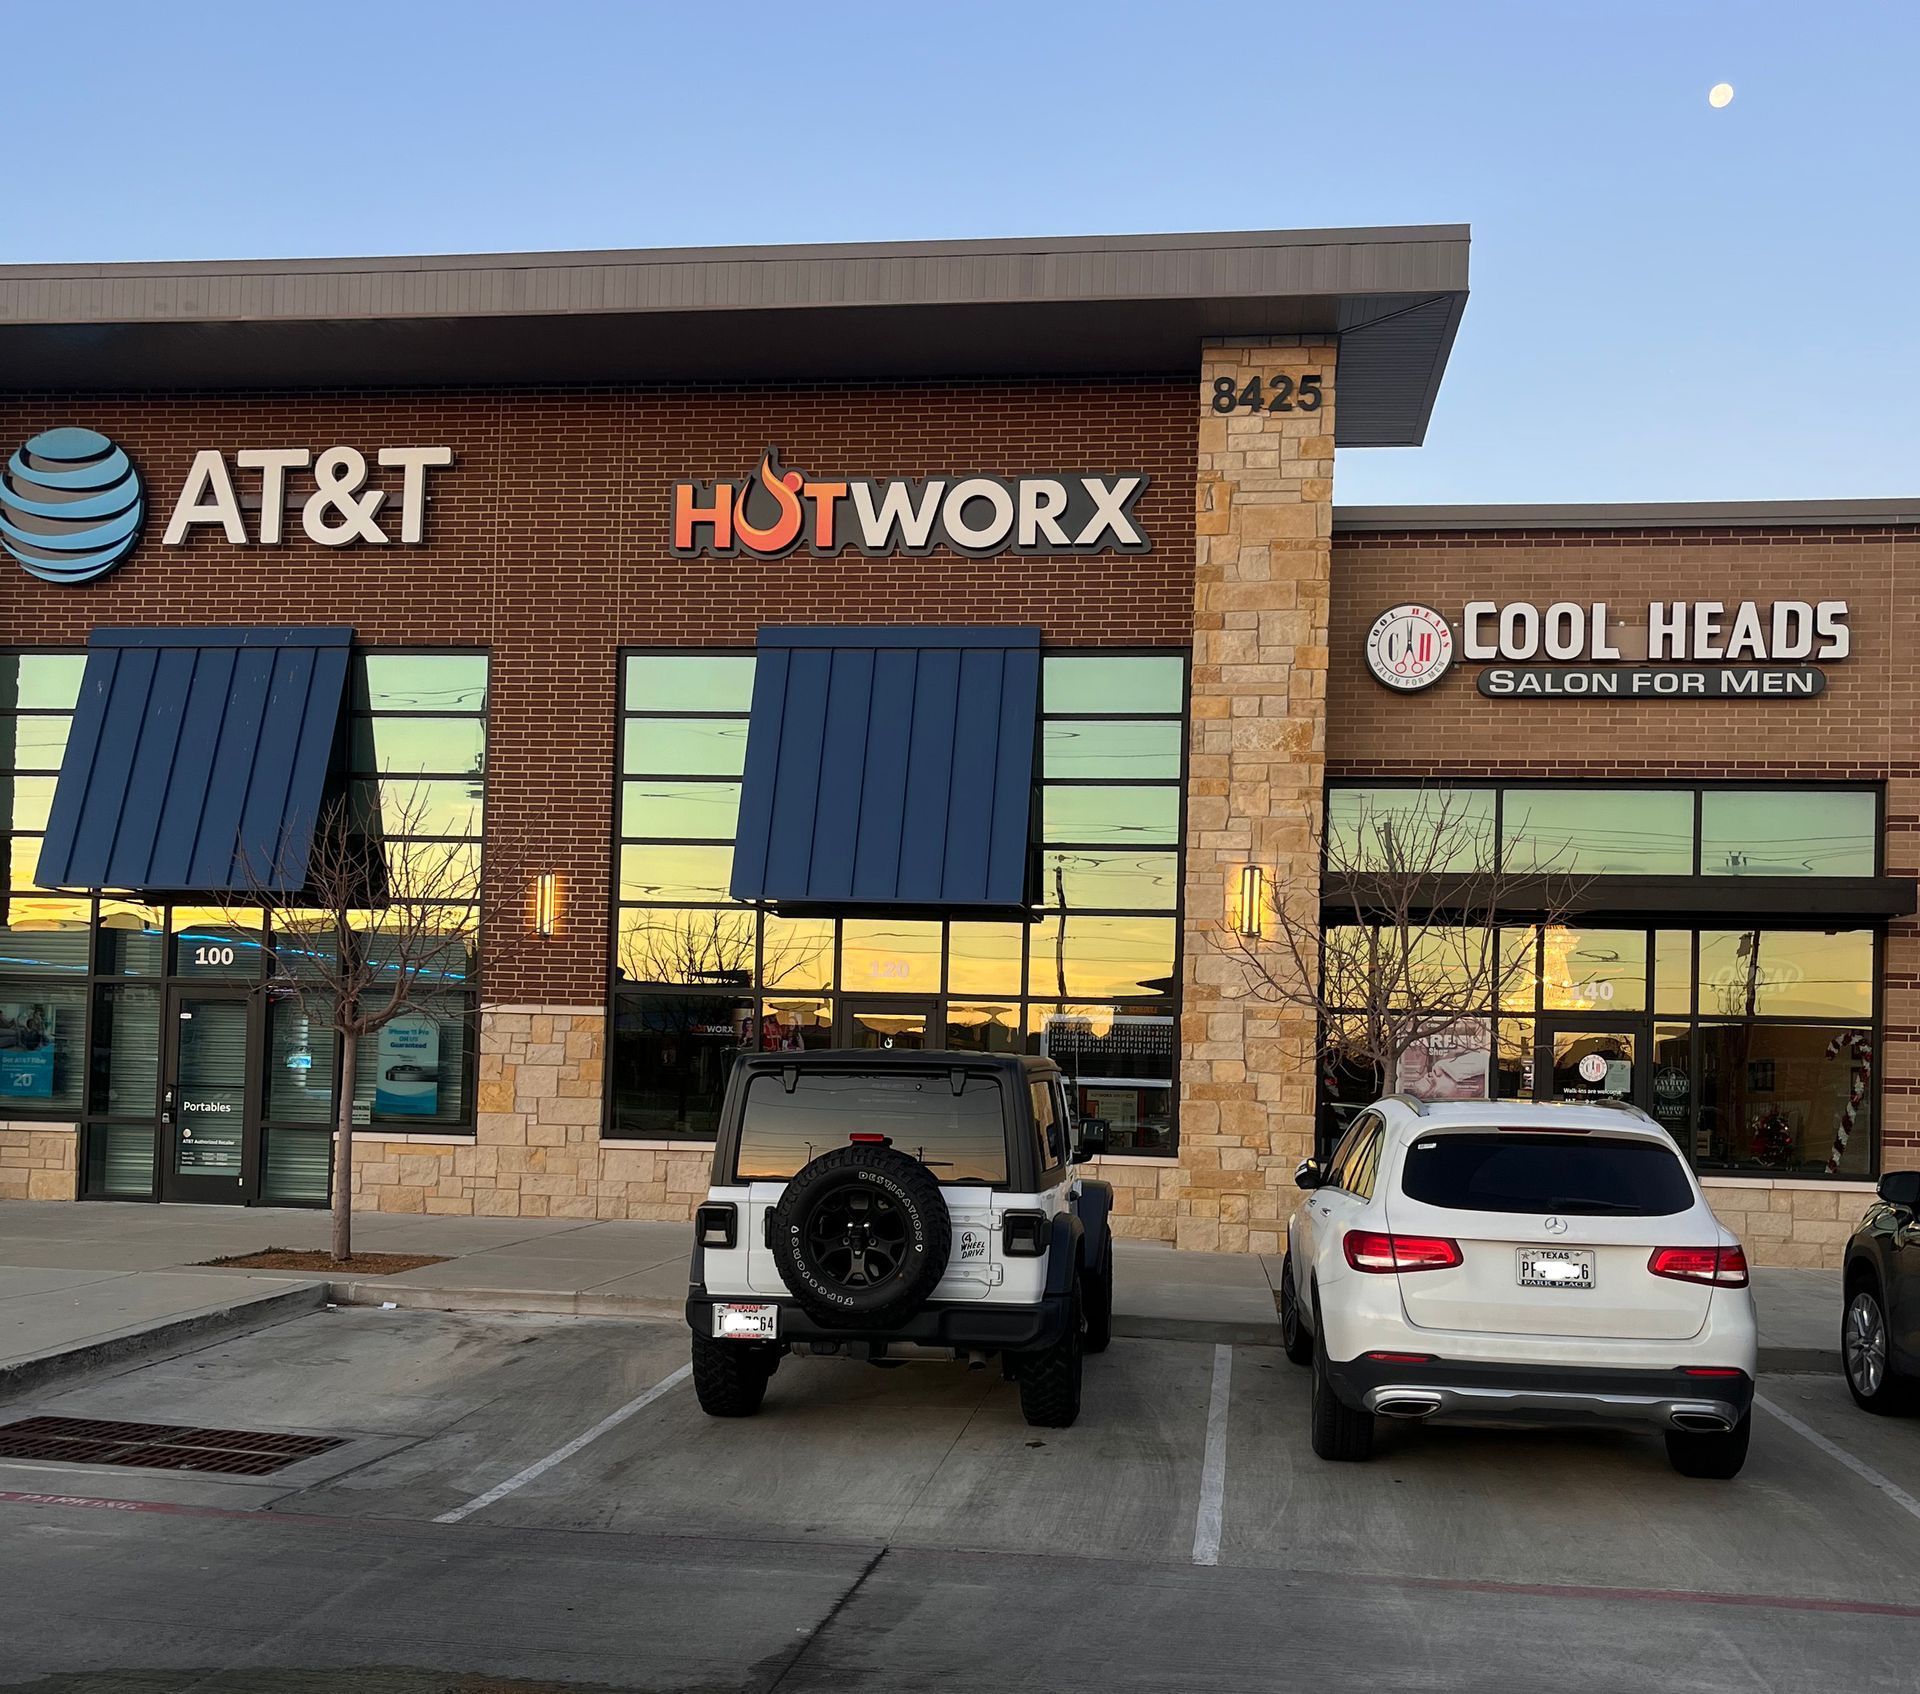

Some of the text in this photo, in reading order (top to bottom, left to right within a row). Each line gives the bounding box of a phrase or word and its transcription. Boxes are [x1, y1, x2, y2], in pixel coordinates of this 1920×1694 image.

[1213, 375, 1322, 413] 8425
[161, 446, 454, 547] AT&T
[674, 449, 1143, 553] HOTWORX
[1370, 608, 1450, 648] COOL HEADS
[1463, 601, 1850, 661] COOL HEADS
[1373, 661, 1445, 687] SALON FOR MEN
[195, 947, 234, 965] 100
[871, 959, 910, 978] 120
[1571, 981, 1614, 1001] 140
[183, 1101, 231, 1112] Portables
[858, 1171, 923, 1241] DESTINATION
[961, 1241, 985, 1251] WHEEL
[962, 1248, 985, 1259] DRIVE
[1540, 1251, 1570, 1260] TEXAS
[1555, 1280, 1589, 1288] PLACE
